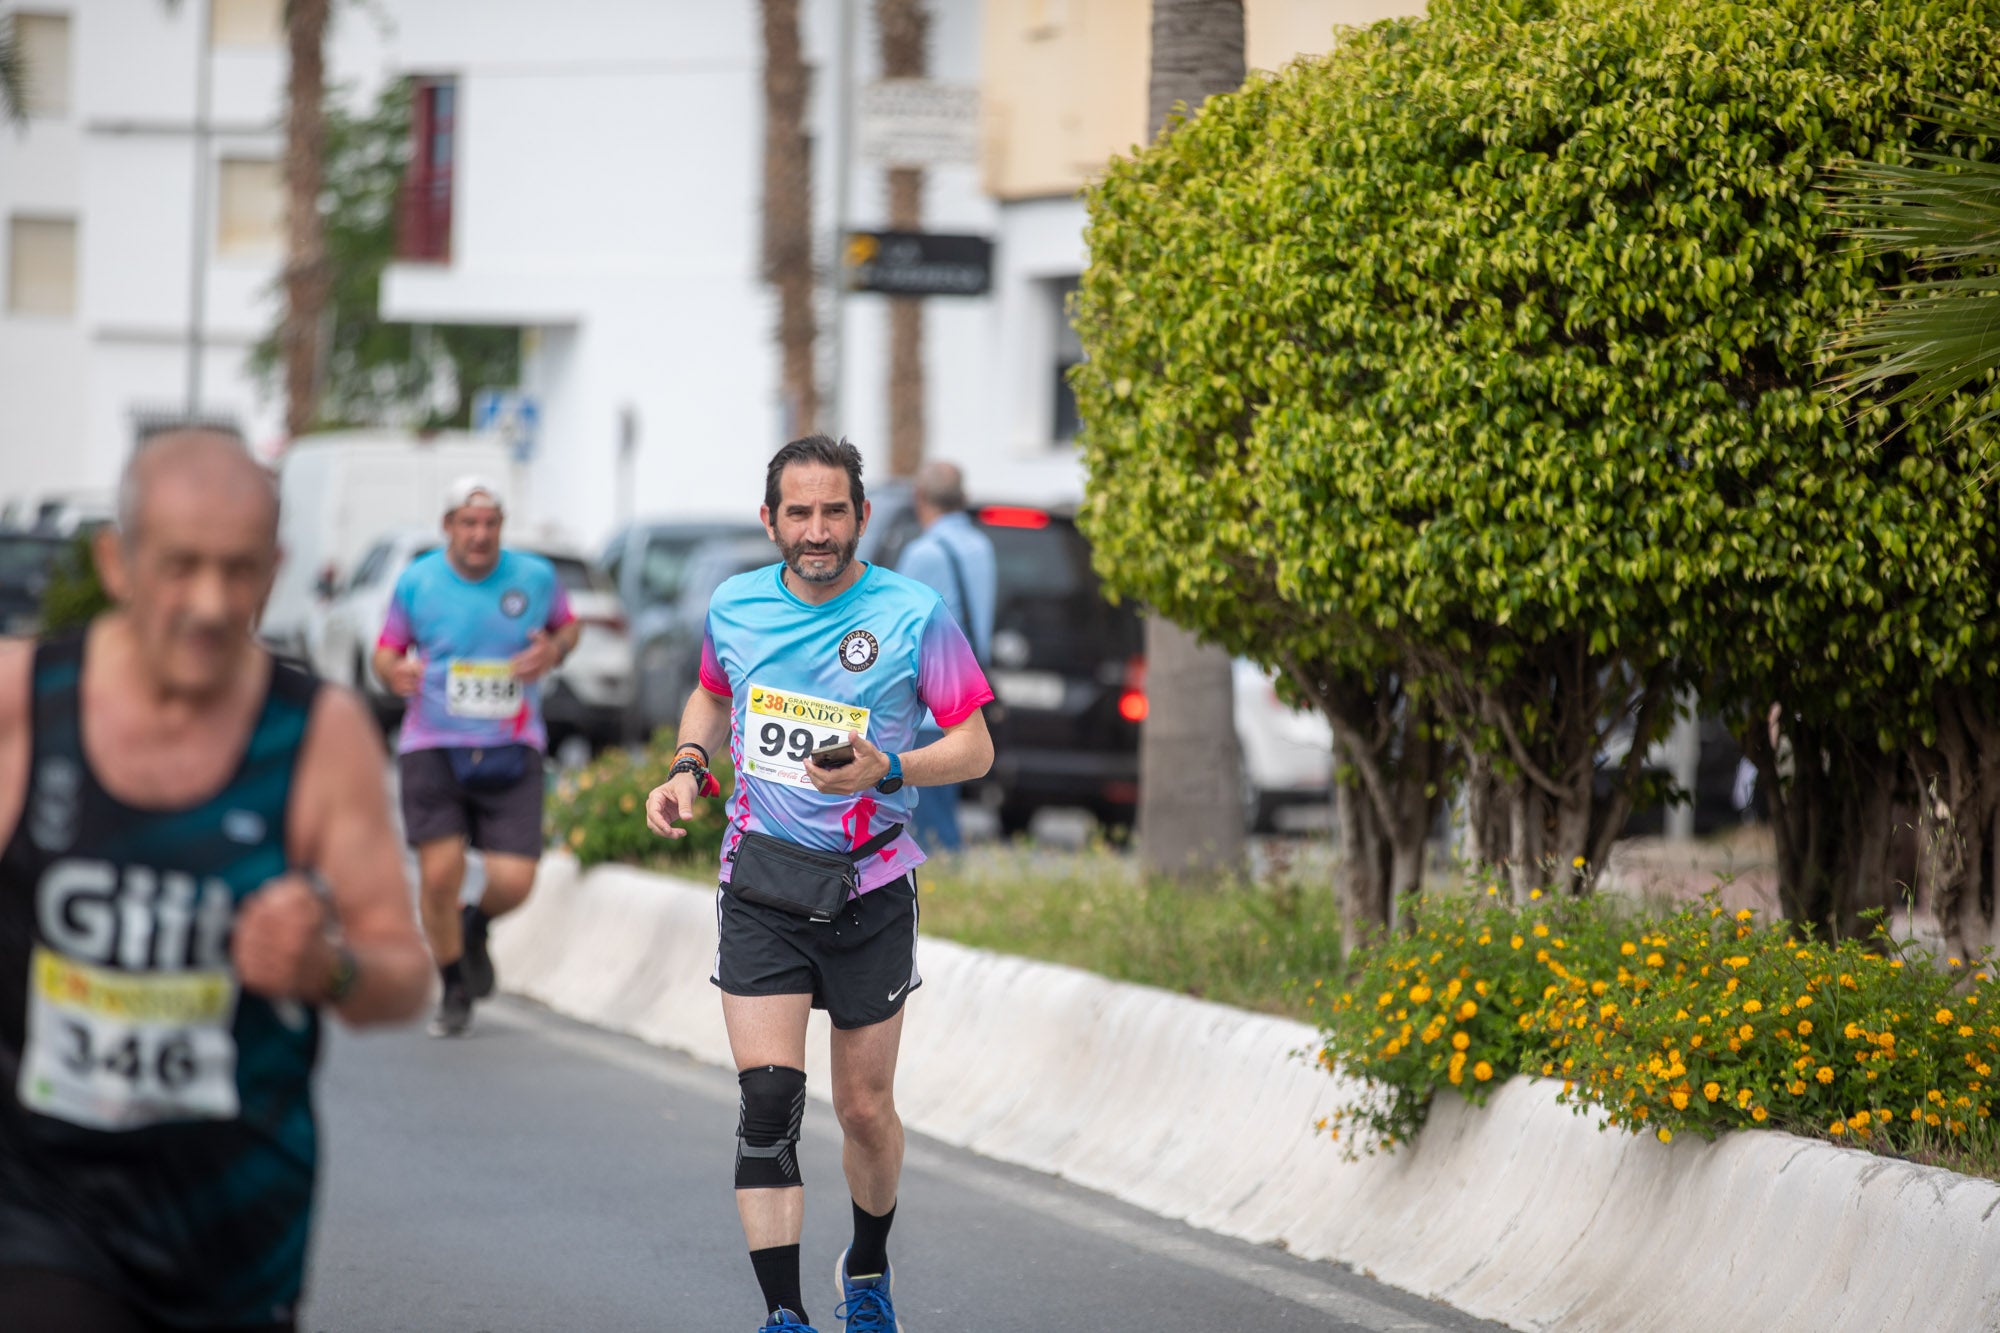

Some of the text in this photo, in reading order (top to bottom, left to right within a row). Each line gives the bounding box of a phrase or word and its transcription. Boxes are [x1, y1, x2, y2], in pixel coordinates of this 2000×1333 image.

[842, 659, 870, 671] GRANADA
[764, 694, 784, 711] 38
[788, 697, 810, 706] GRAN
[810, 701, 839, 712] PREMIO
[783, 702, 843, 724] FONDO
[62, 1020, 196, 1092] 346
